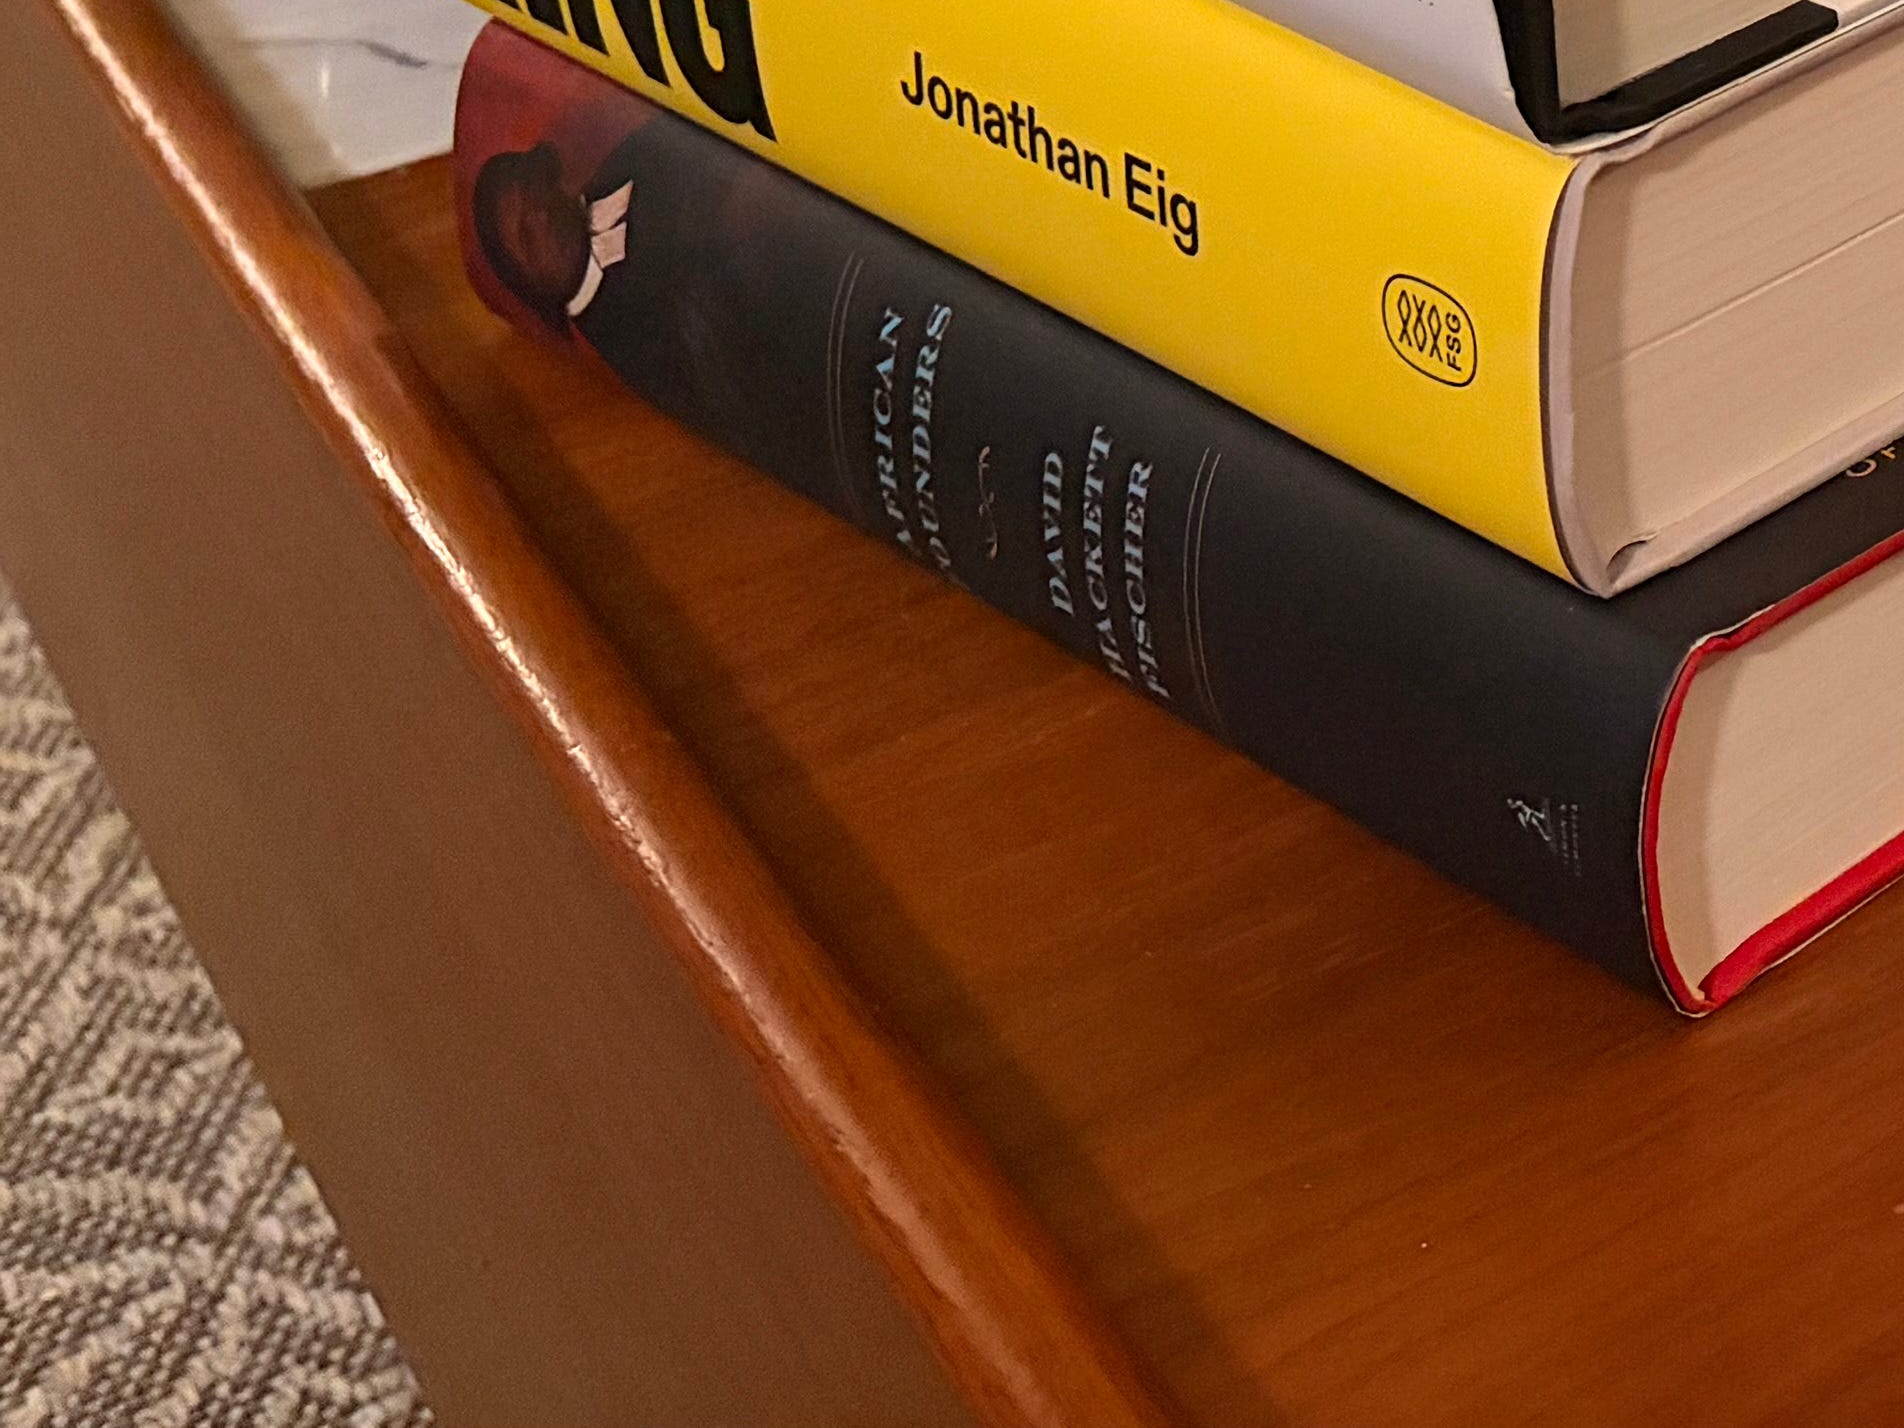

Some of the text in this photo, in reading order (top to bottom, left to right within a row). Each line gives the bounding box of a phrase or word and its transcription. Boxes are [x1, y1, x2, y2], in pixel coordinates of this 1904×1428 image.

[900, 50, 1201, 258] Jonathan Eig
[912, 304, 958, 578] OUNDERS
[1446, 310, 1464, 374] FSG
[1041, 451, 1075, 618] DAVID
[1082, 425, 1135, 684] HACKETT
[1124, 460, 1173, 700] FISCHER
